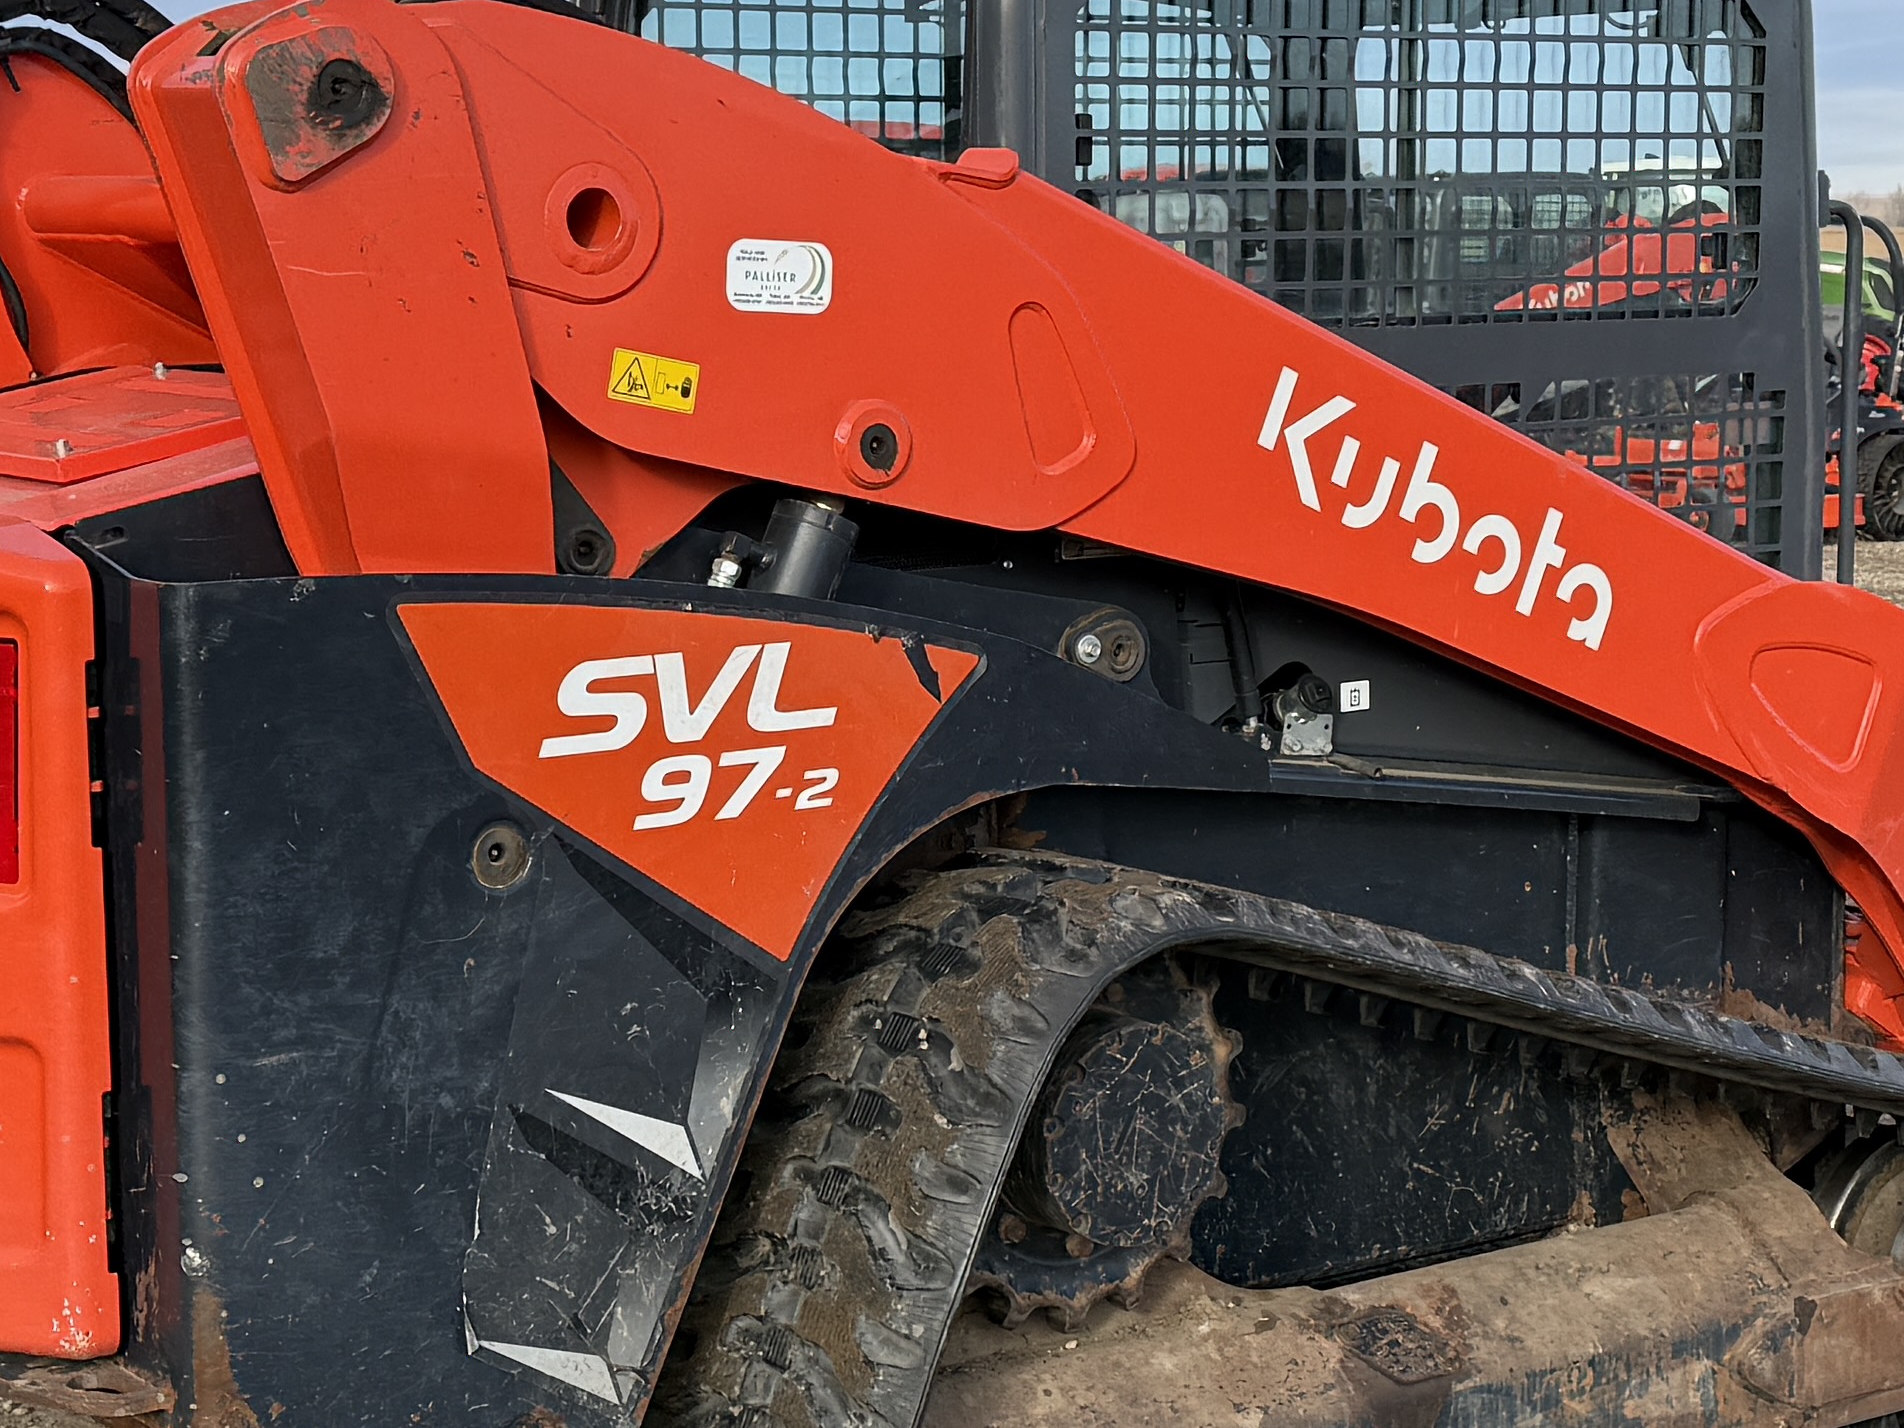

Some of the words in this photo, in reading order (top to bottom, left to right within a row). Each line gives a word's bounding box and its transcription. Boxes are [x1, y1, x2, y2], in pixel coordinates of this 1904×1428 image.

[745, 270, 796, 283] PALLISER
[1257, 365, 1612, 651] Kubota
[538, 641, 838, 759] SVL
[632, 745, 839, 831] 97-2
